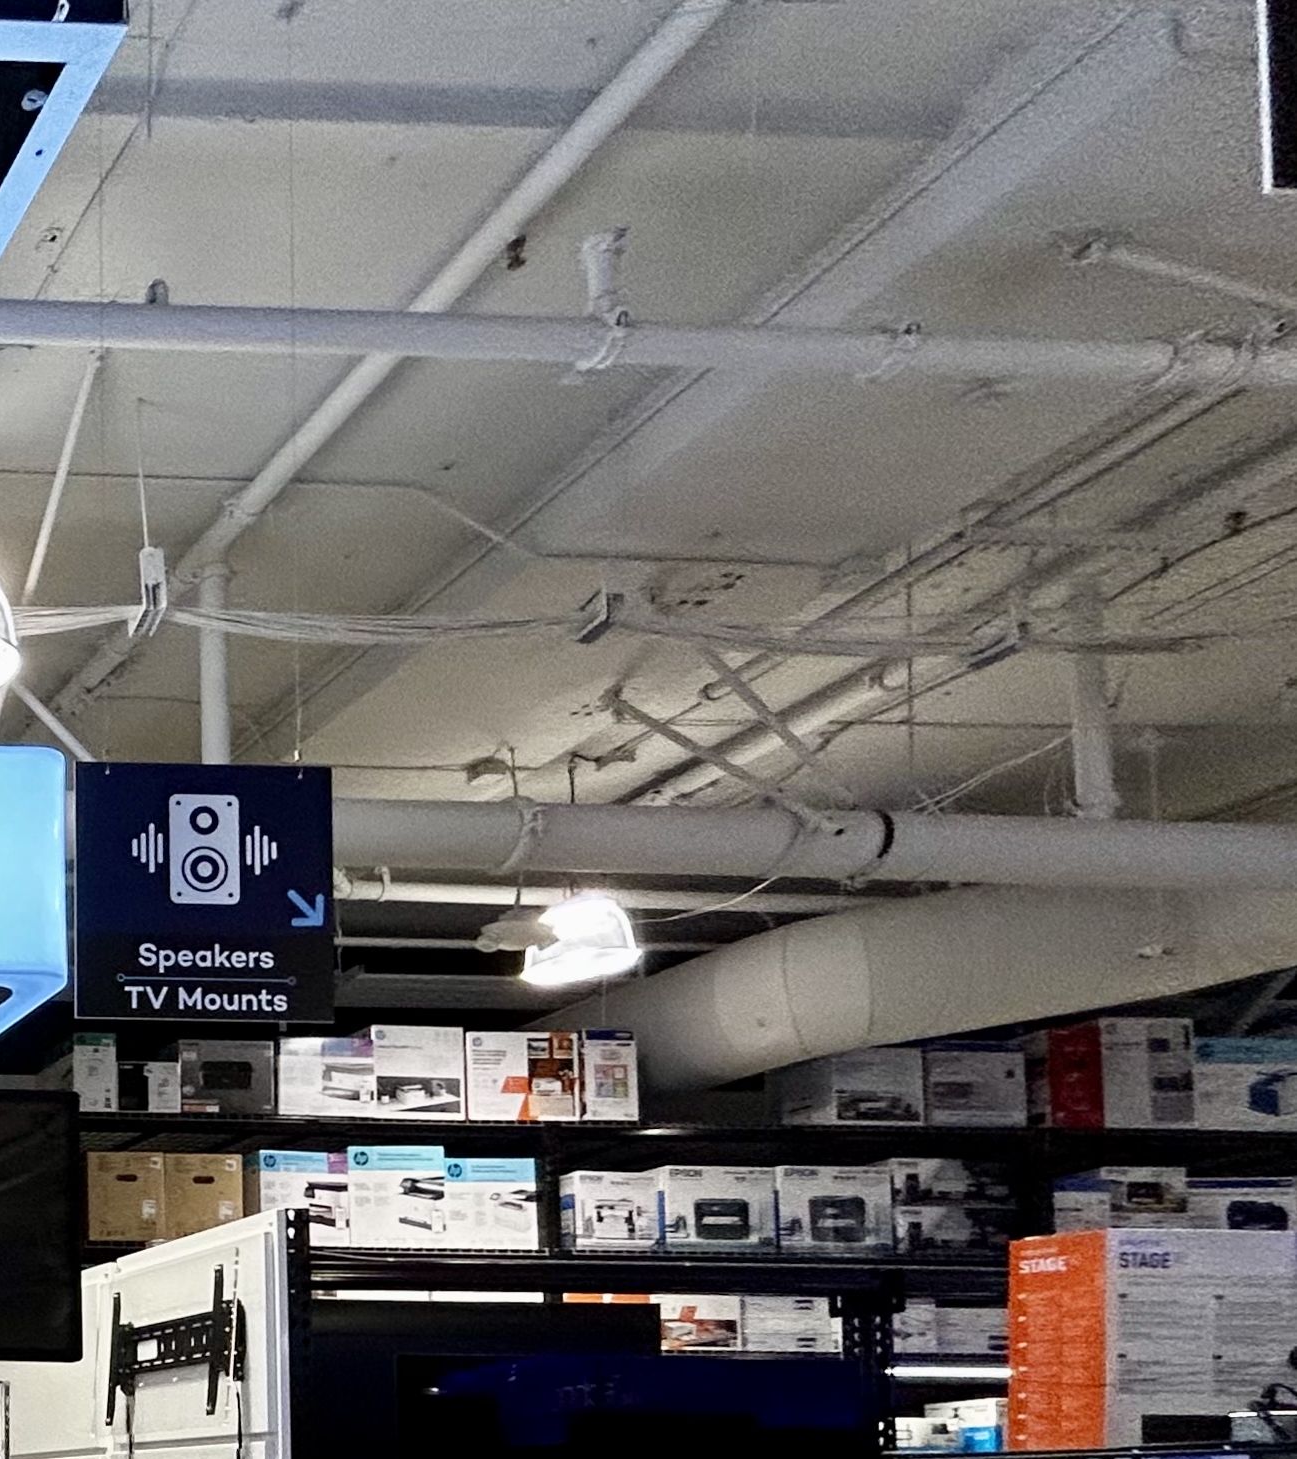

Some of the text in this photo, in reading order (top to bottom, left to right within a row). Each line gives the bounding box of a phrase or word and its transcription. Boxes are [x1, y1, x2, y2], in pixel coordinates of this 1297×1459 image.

[138, 942, 275, 974] Speakers
[124, 986, 288, 1012] TV Mounts
[1018, 1256, 1068, 1274] STAGE
[1119, 1251, 1171, 1269] STAGE
